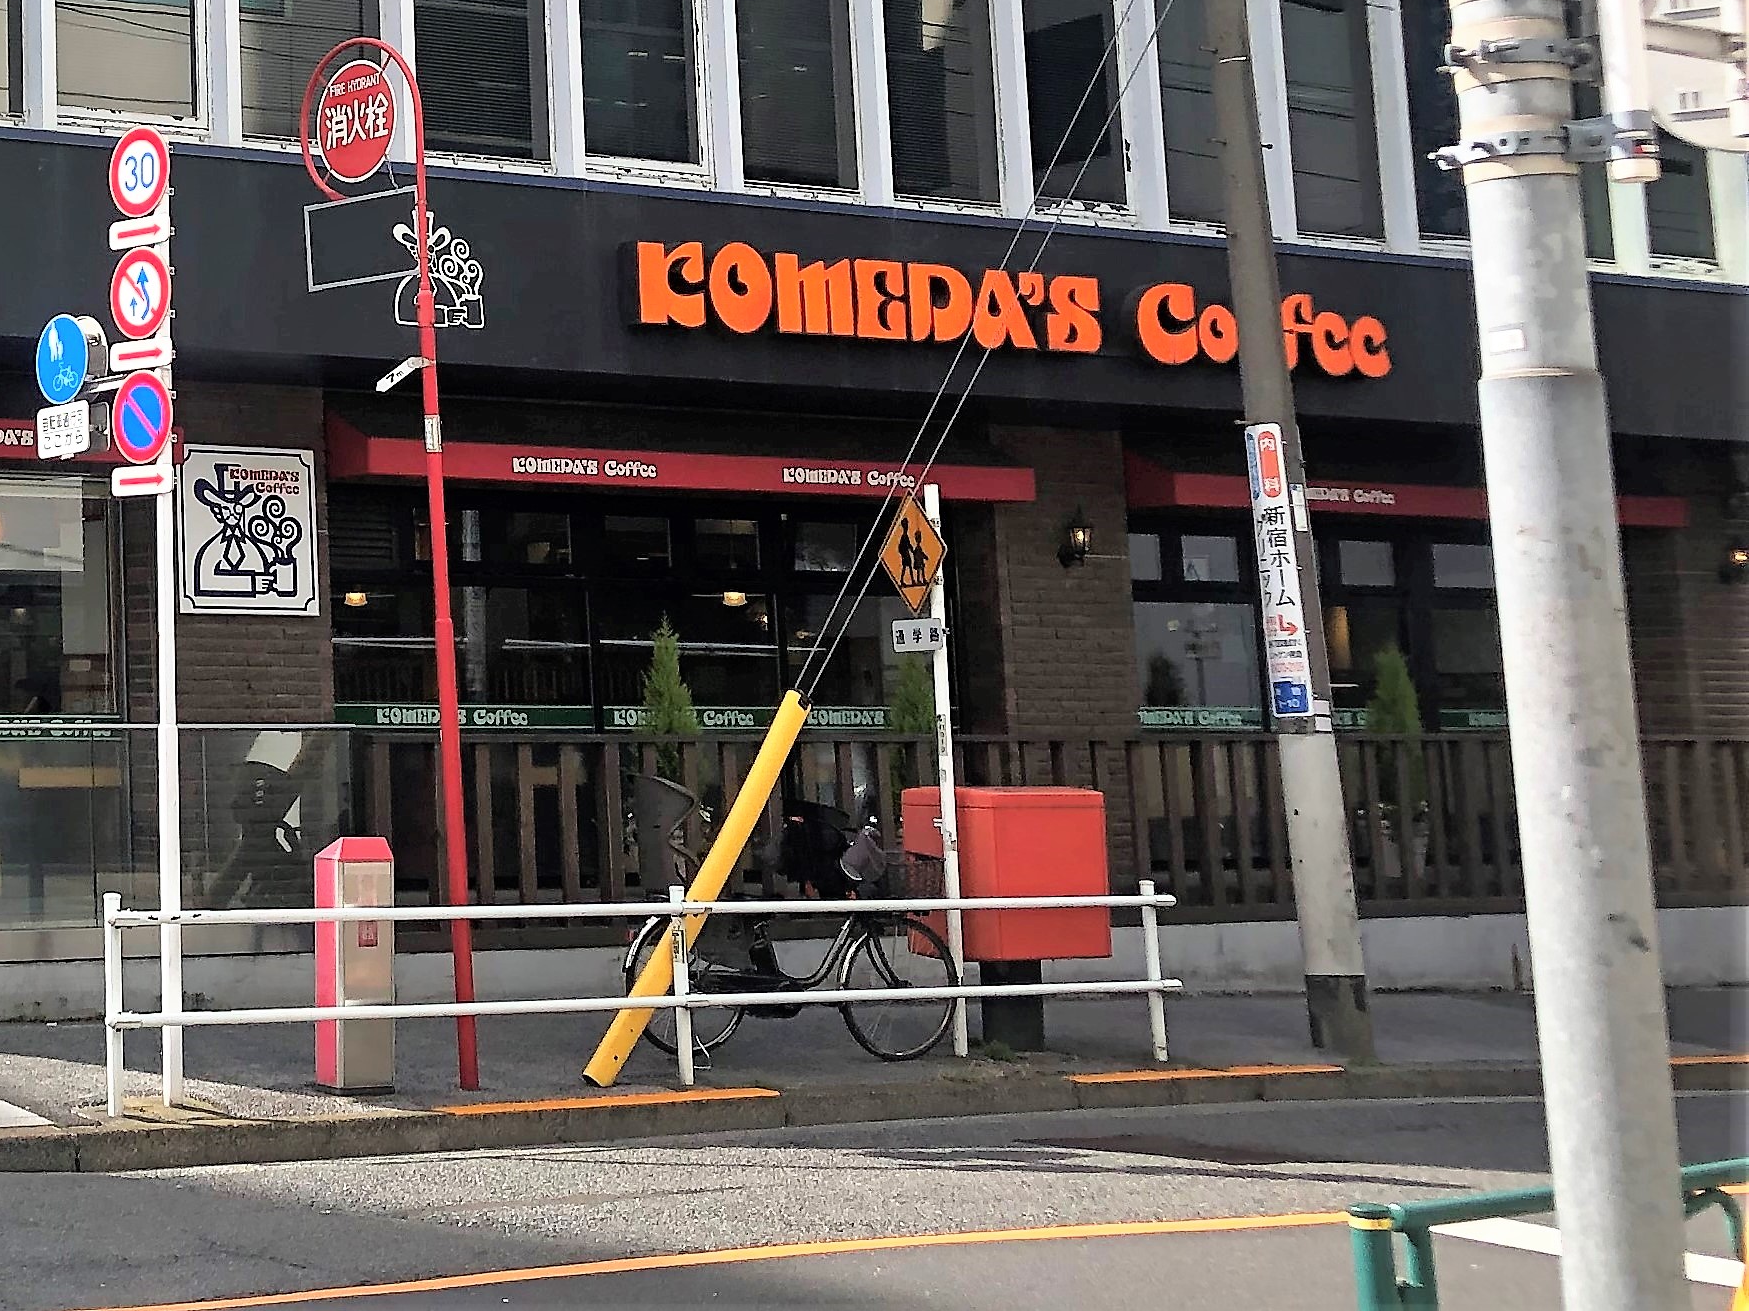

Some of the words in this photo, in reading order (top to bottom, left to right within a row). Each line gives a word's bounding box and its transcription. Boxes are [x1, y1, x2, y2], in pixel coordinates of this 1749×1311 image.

[330, 80, 346, 98] FIRE
[324, 92, 389, 151] 消火栓
[125, 152, 154, 192] 30
[637, 241, 1102, 353] KOMEDA'S
[1137, 283, 1392, 378] Cofee
[229, 468, 300, 483] KOMEDA'S
[512, 457, 599, 475] KOMEDA'S
[604, 460, 658, 478] Coffee
[782, 467, 862, 485] KOMEDA'S
[255, 481, 300, 495] Coffee
[1264, 506, 1296, 607] 新宿ホーム
[473, 709, 529, 726] Coffee
[703, 710, 754, 726] Coffee
